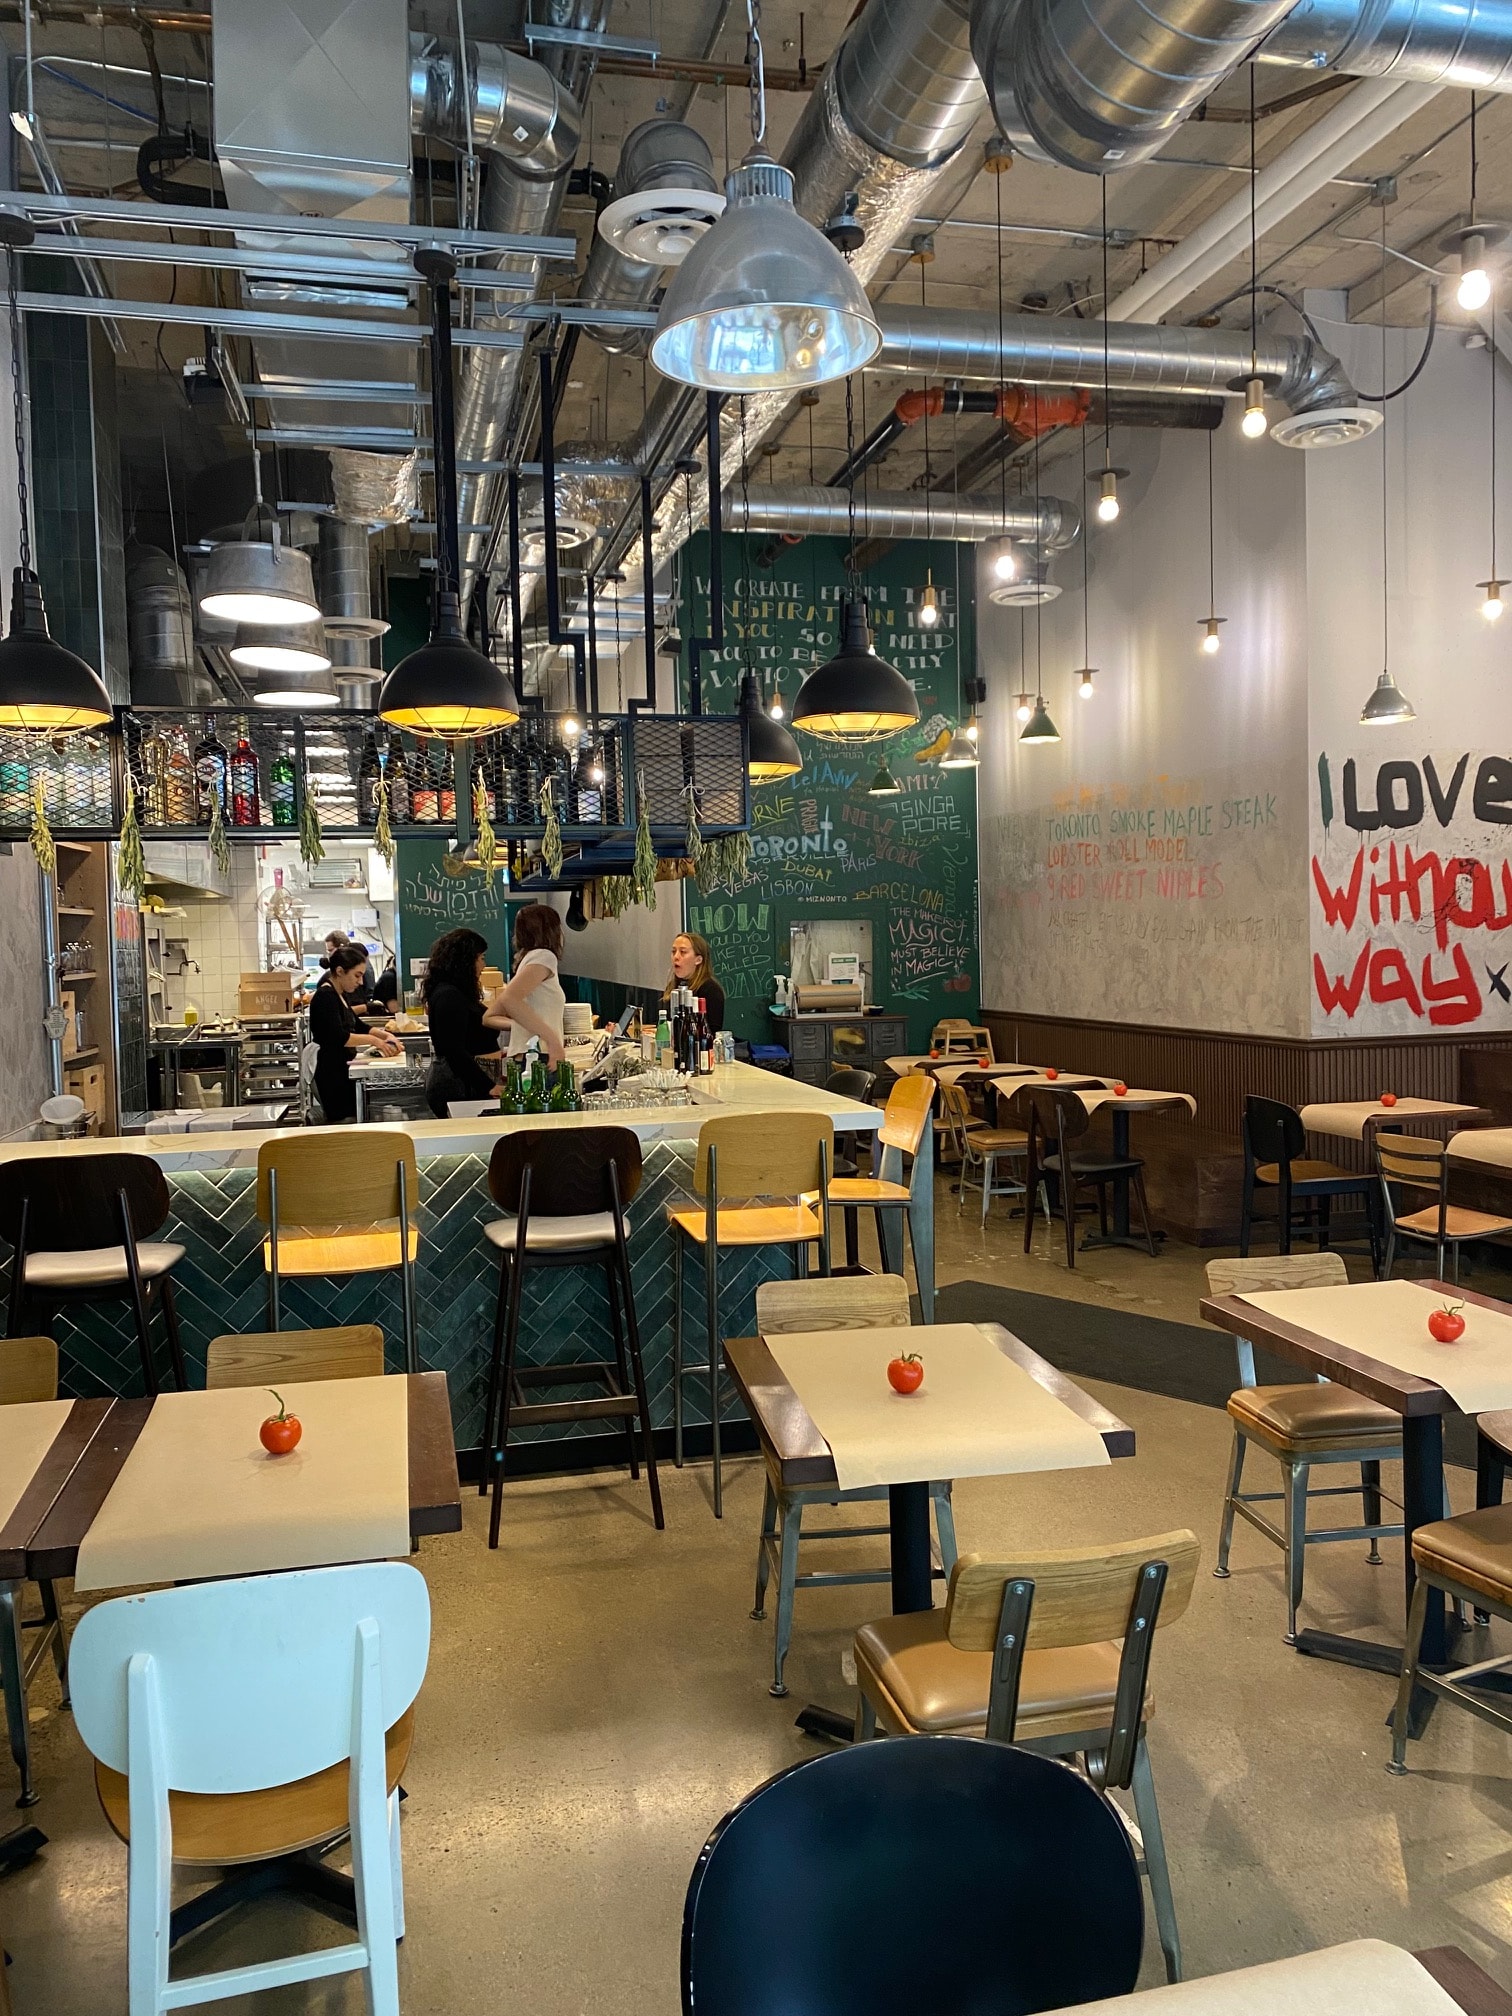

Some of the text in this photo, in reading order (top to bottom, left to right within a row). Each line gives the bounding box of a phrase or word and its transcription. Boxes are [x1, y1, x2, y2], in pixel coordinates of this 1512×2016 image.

[734, 578, 805, 599] CREATE
[798, 627, 832, 646] SO
[889, 633, 954, 650] NEED
[756, 645, 783, 660] TO
[788, 646, 828, 663] BE
[901, 795, 955, 819] SINGA
[1164, 805, 1213, 838] MAPLE
[1222, 792, 1277, 830] STEAK
[842, 803, 898, 835] NEW
[902, 815, 962, 836] PORE
[840, 851, 877, 873] PARIS
[874, 833, 924, 871] YORK
[1047, 841, 1102, 869] LOBSTER
[1145, 836, 1194, 862] MODEL
[724, 870, 769, 898] VEGAS
[761, 880, 814, 901] LISBON
[1060, 872, 1085, 900] RED
[1092, 868, 1148, 902] SWEET
[853, 881, 944, 913] BARCELONA
[690, 903, 770, 935] HOW
[890, 907, 911, 918] THE
[746, 930, 770, 944] YOU
[738, 943, 759, 956] TO
[891, 943, 971, 964] MUST BELIEVE
[713, 954, 772, 976] CALLED
[891, 957, 953, 977] IN MAGIC
